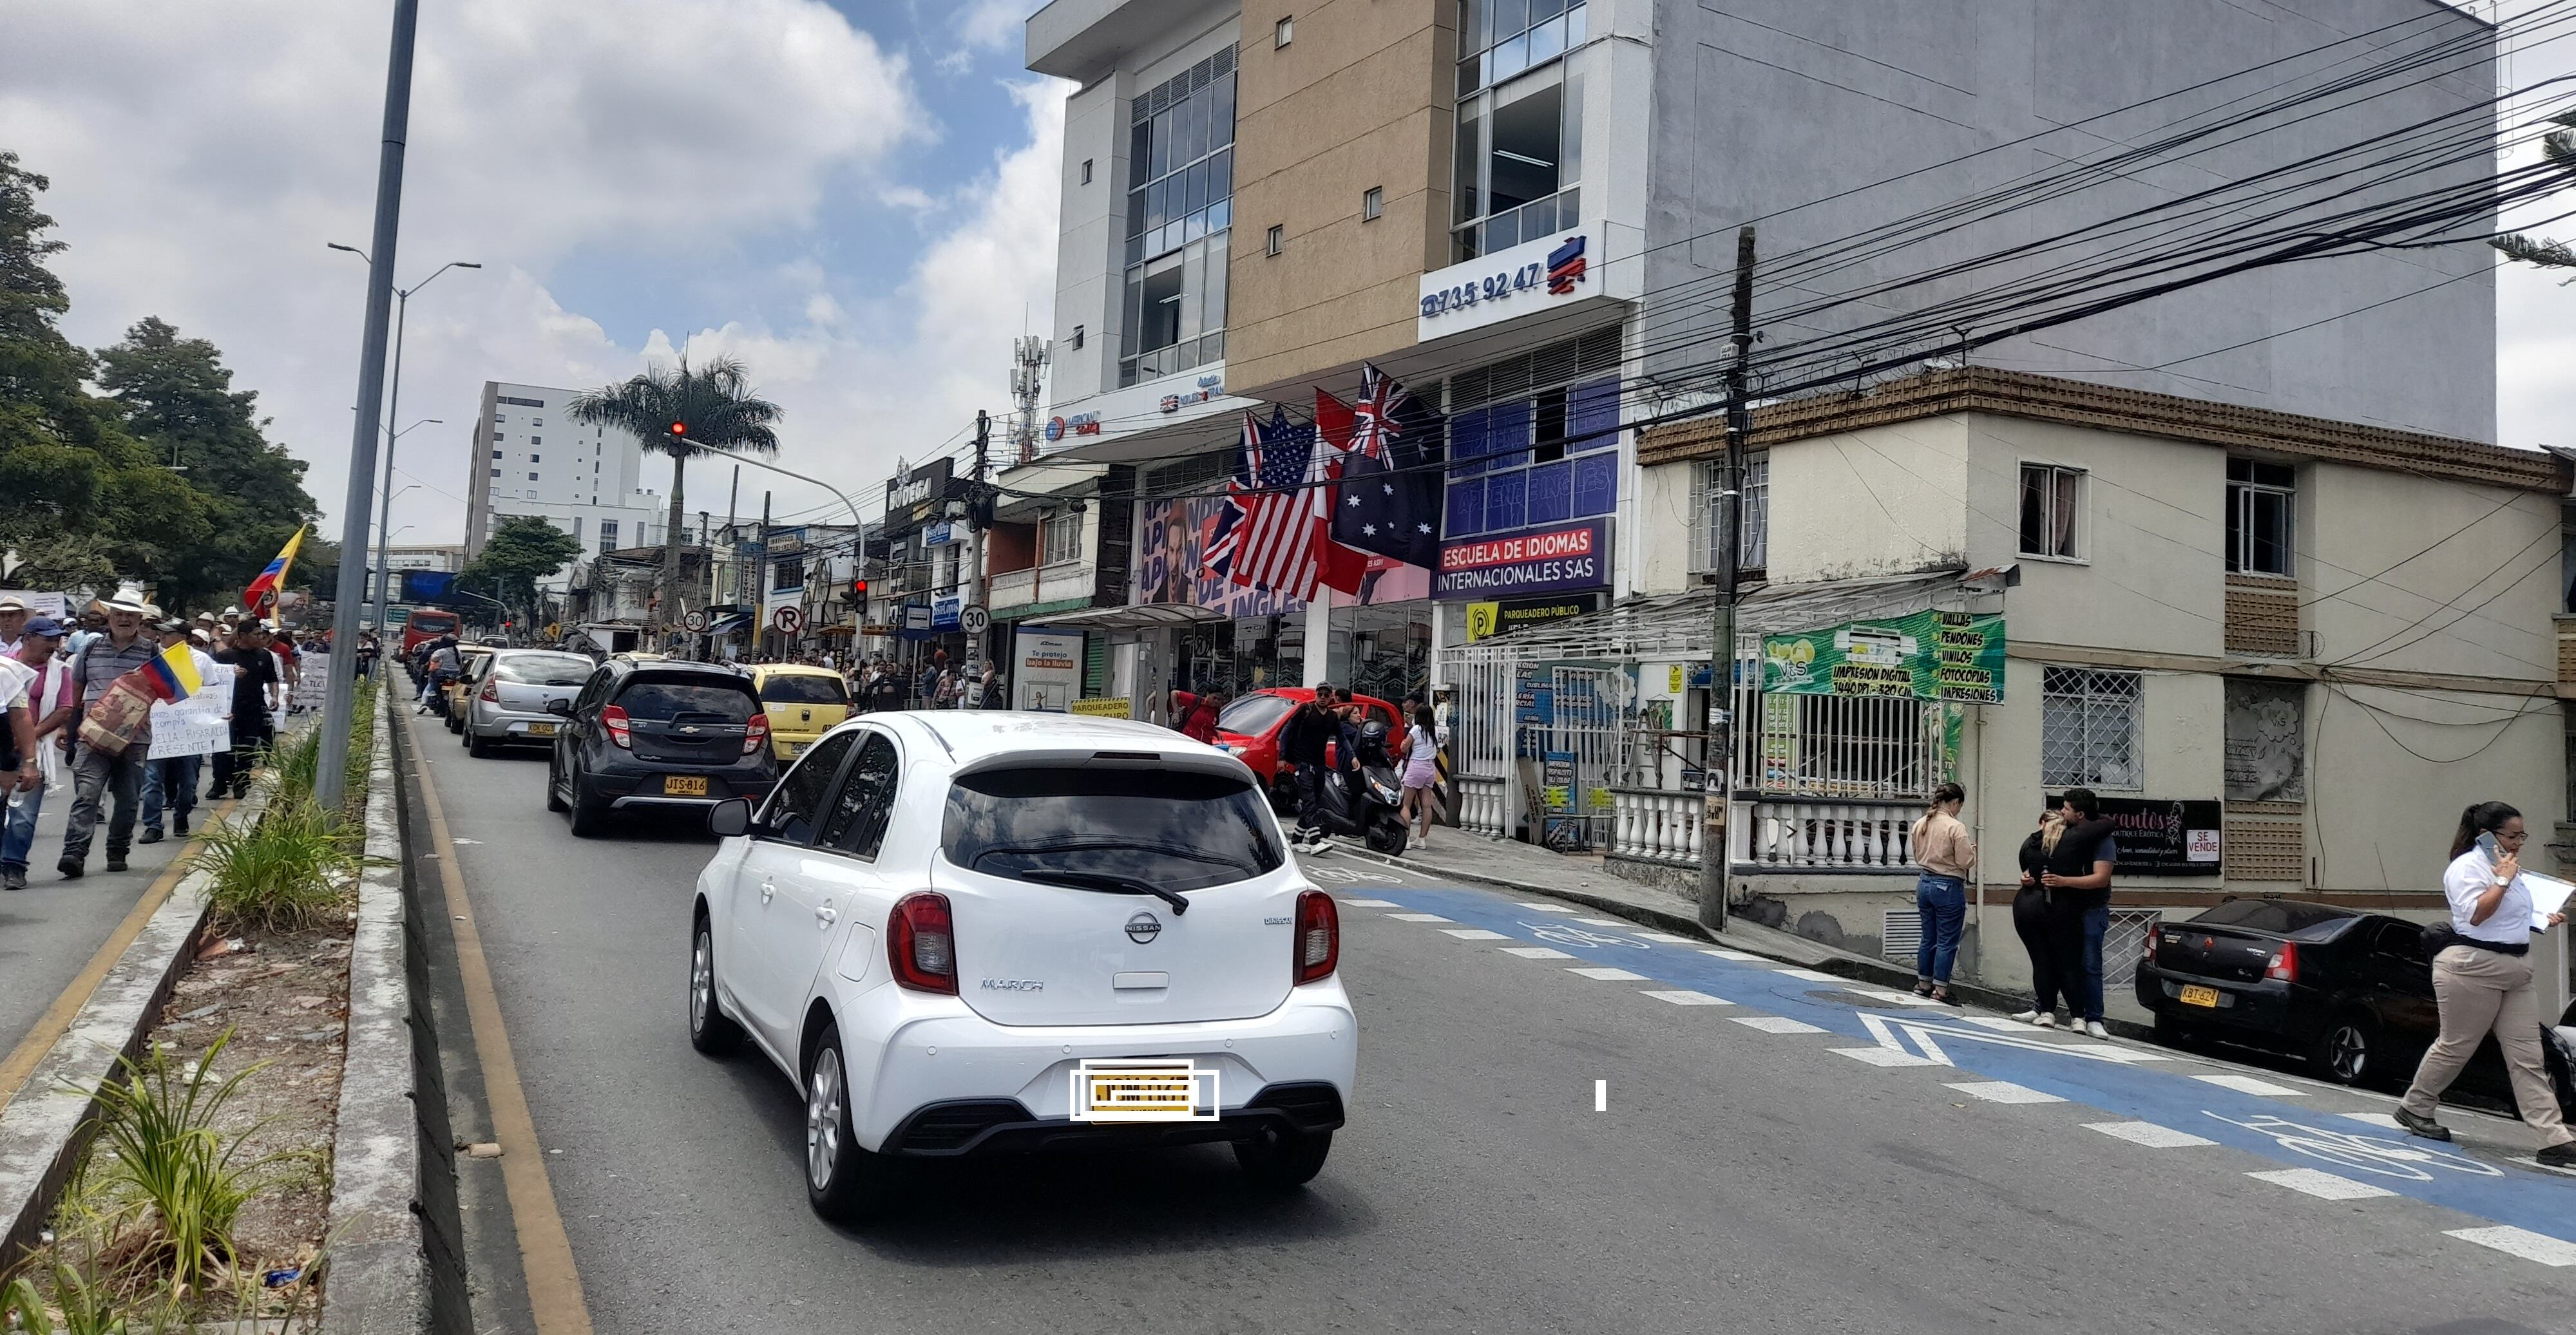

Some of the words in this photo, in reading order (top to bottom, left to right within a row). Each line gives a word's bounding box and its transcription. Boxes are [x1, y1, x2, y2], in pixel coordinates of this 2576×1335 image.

[1438, 281, 1479, 313] 735
[1483, 272, 1511, 301] 92
[1514, 263, 1543, 290] 47
[889, 477, 932, 511] BODEGA
[1444, 542, 1500, 567] ESCUELA
[1503, 540, 1522, 560] DE
[1526, 531, 1589, 558] IDIOMAS
[1437, 561, 1561, 592] INTERNACIONALES
[1565, 557, 1594, 580] SAS
[966, 612, 985, 627] 30
[1504, 607, 1549, 620] PARQUEADERO
[1551, 604, 1579, 618] PÚBLICO
[687, 615, 703, 627] 30
[1477, 617, 1484, 632] P
[1942, 613, 1972, 627] VALLAS
[1941, 631, 1983, 646] PENDONES
[1027, 658, 1042, 667] bajo
[1942, 650, 1972, 664] VINILOS
[1880, 668, 1912, 683] DIGITAL
[1940, 668, 1990, 683] FOTOCOPIAS
[1833, 682, 1856, 695] 1440
[1879, 683, 1897, 696] 320
[1899, 685, 1913, 697] CM
[1941, 686, 1997, 701] IMPRESIONES
[214, 703, 222, 714] de
[1072, 703, 1129, 712] PARQUEADERO
[155, 719, 186, 729] compra
[186, 726, 228, 739] RISARALDA
[150, 741, 207, 756] PRESENTE
[2197, 831, 2208, 842] SE
[2189, 842, 2217, 852] VENDE
[980, 977, 1044, 992] MARCH
